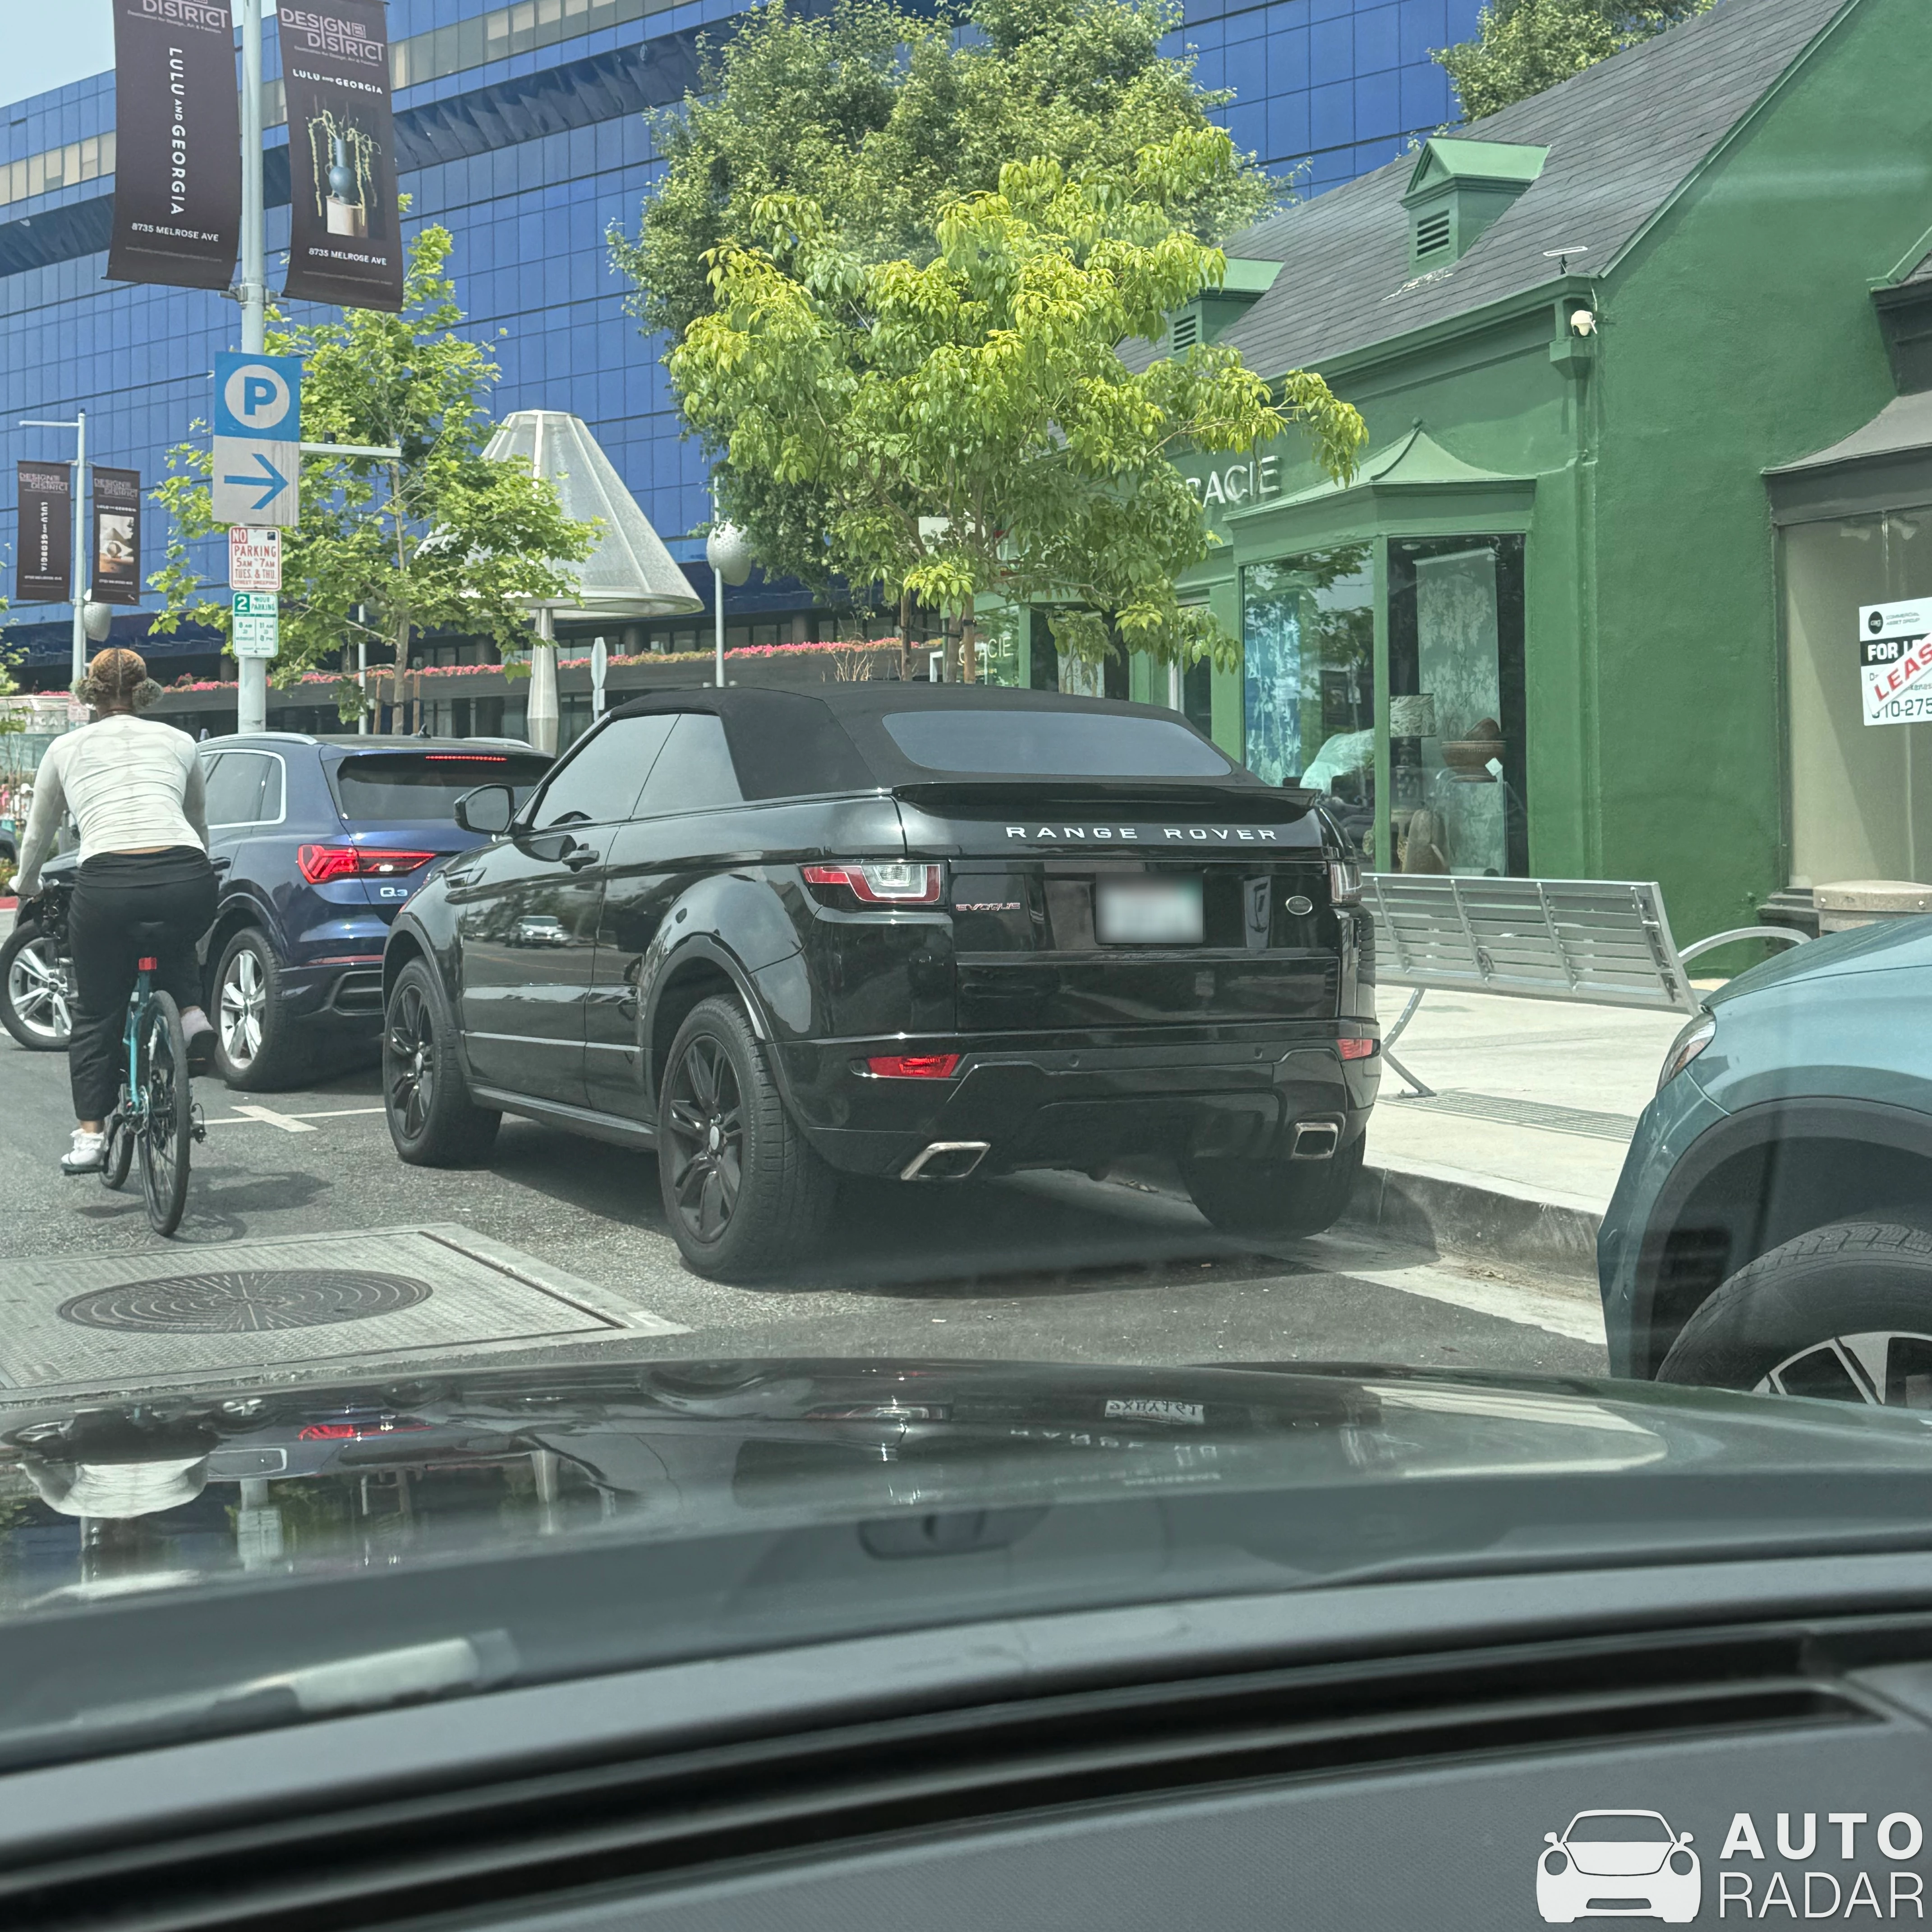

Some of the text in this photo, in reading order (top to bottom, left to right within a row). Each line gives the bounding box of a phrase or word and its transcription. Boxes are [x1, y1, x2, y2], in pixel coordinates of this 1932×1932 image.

[142, 0, 228, 28] DISTRICT
[281, 8, 352, 36] DESIGN
[307, 32, 385, 62] DISTRICT
[293, 69, 320, 81] LULU
[335, 78, 383, 94] GEORGIA
[169, 47, 186, 214] LULU AND GEORGIA
[132, 222, 219, 242] 8735 MELROSE AVE
[308, 248, 387, 266] 8735 MELROSE AVE
[244, 376, 277, 416] P
[232, 529, 247, 543] NO
[235, 545, 276, 557] PARKING
[255, 569, 261, 579] &
[237, 596, 248, 610] 2
[1868, 642, 1899, 662] FOR
[1006, 827, 1277, 840] RANGE ROVER
[380, 887, 408, 897] Q3
